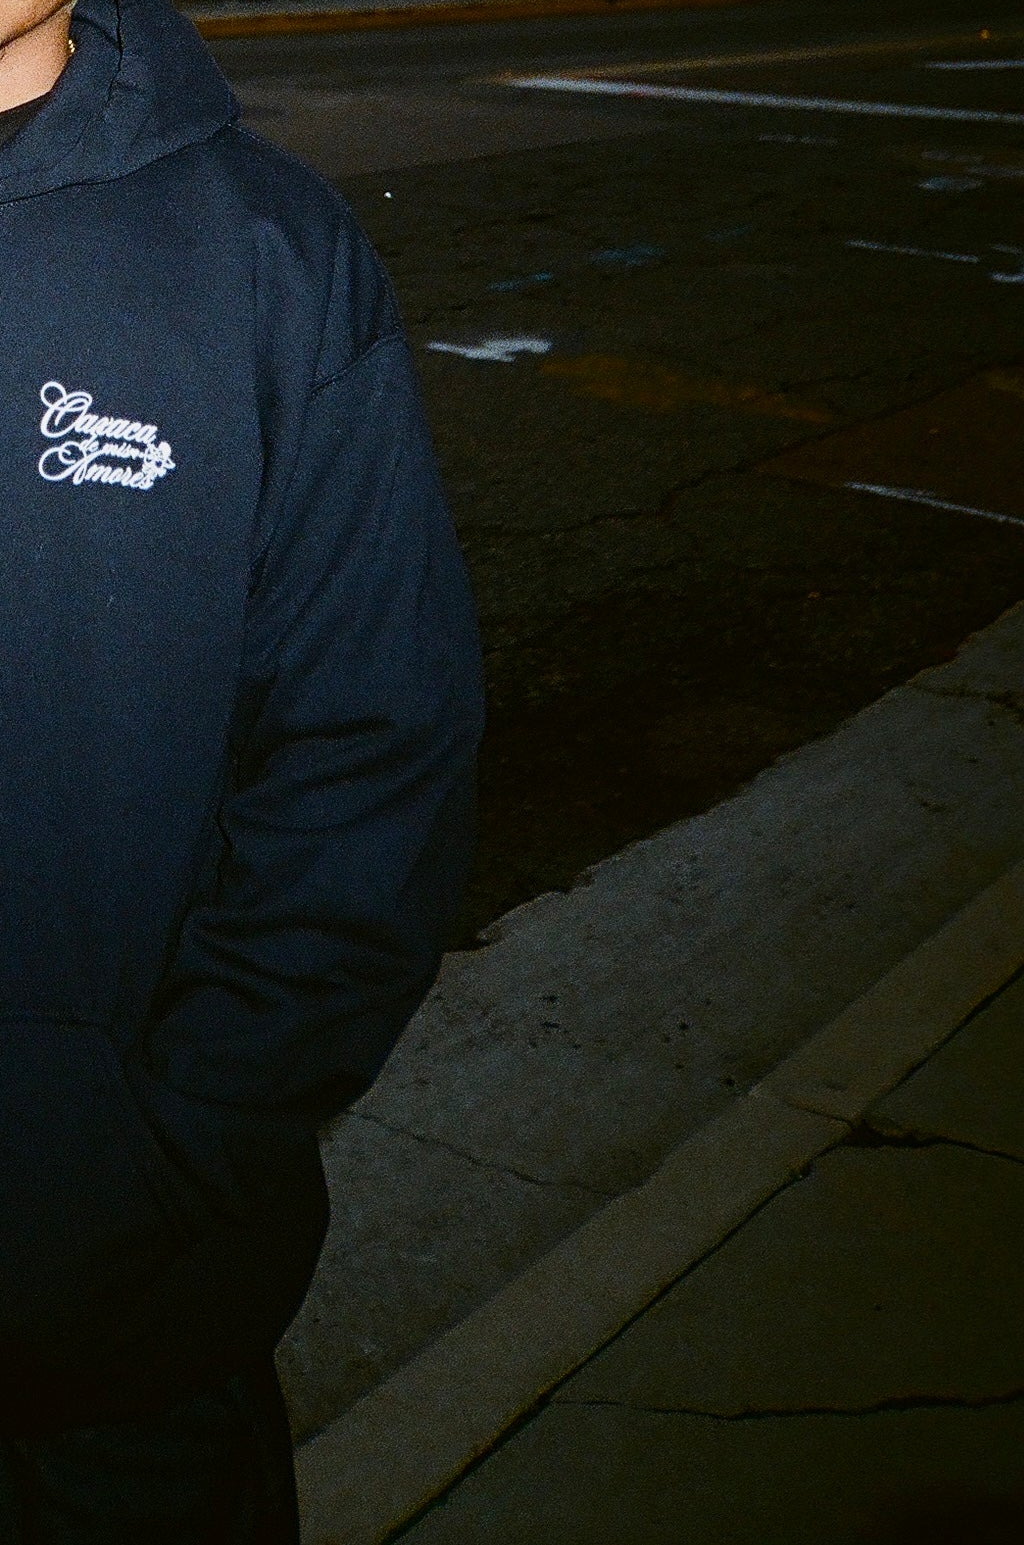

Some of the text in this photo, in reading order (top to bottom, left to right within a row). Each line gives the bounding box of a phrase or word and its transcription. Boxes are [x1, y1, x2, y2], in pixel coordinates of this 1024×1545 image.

[40, 381, 158, 444] Oaxaca
[38, 440, 154, 491] Amores
[79, 433, 100, 453] de
